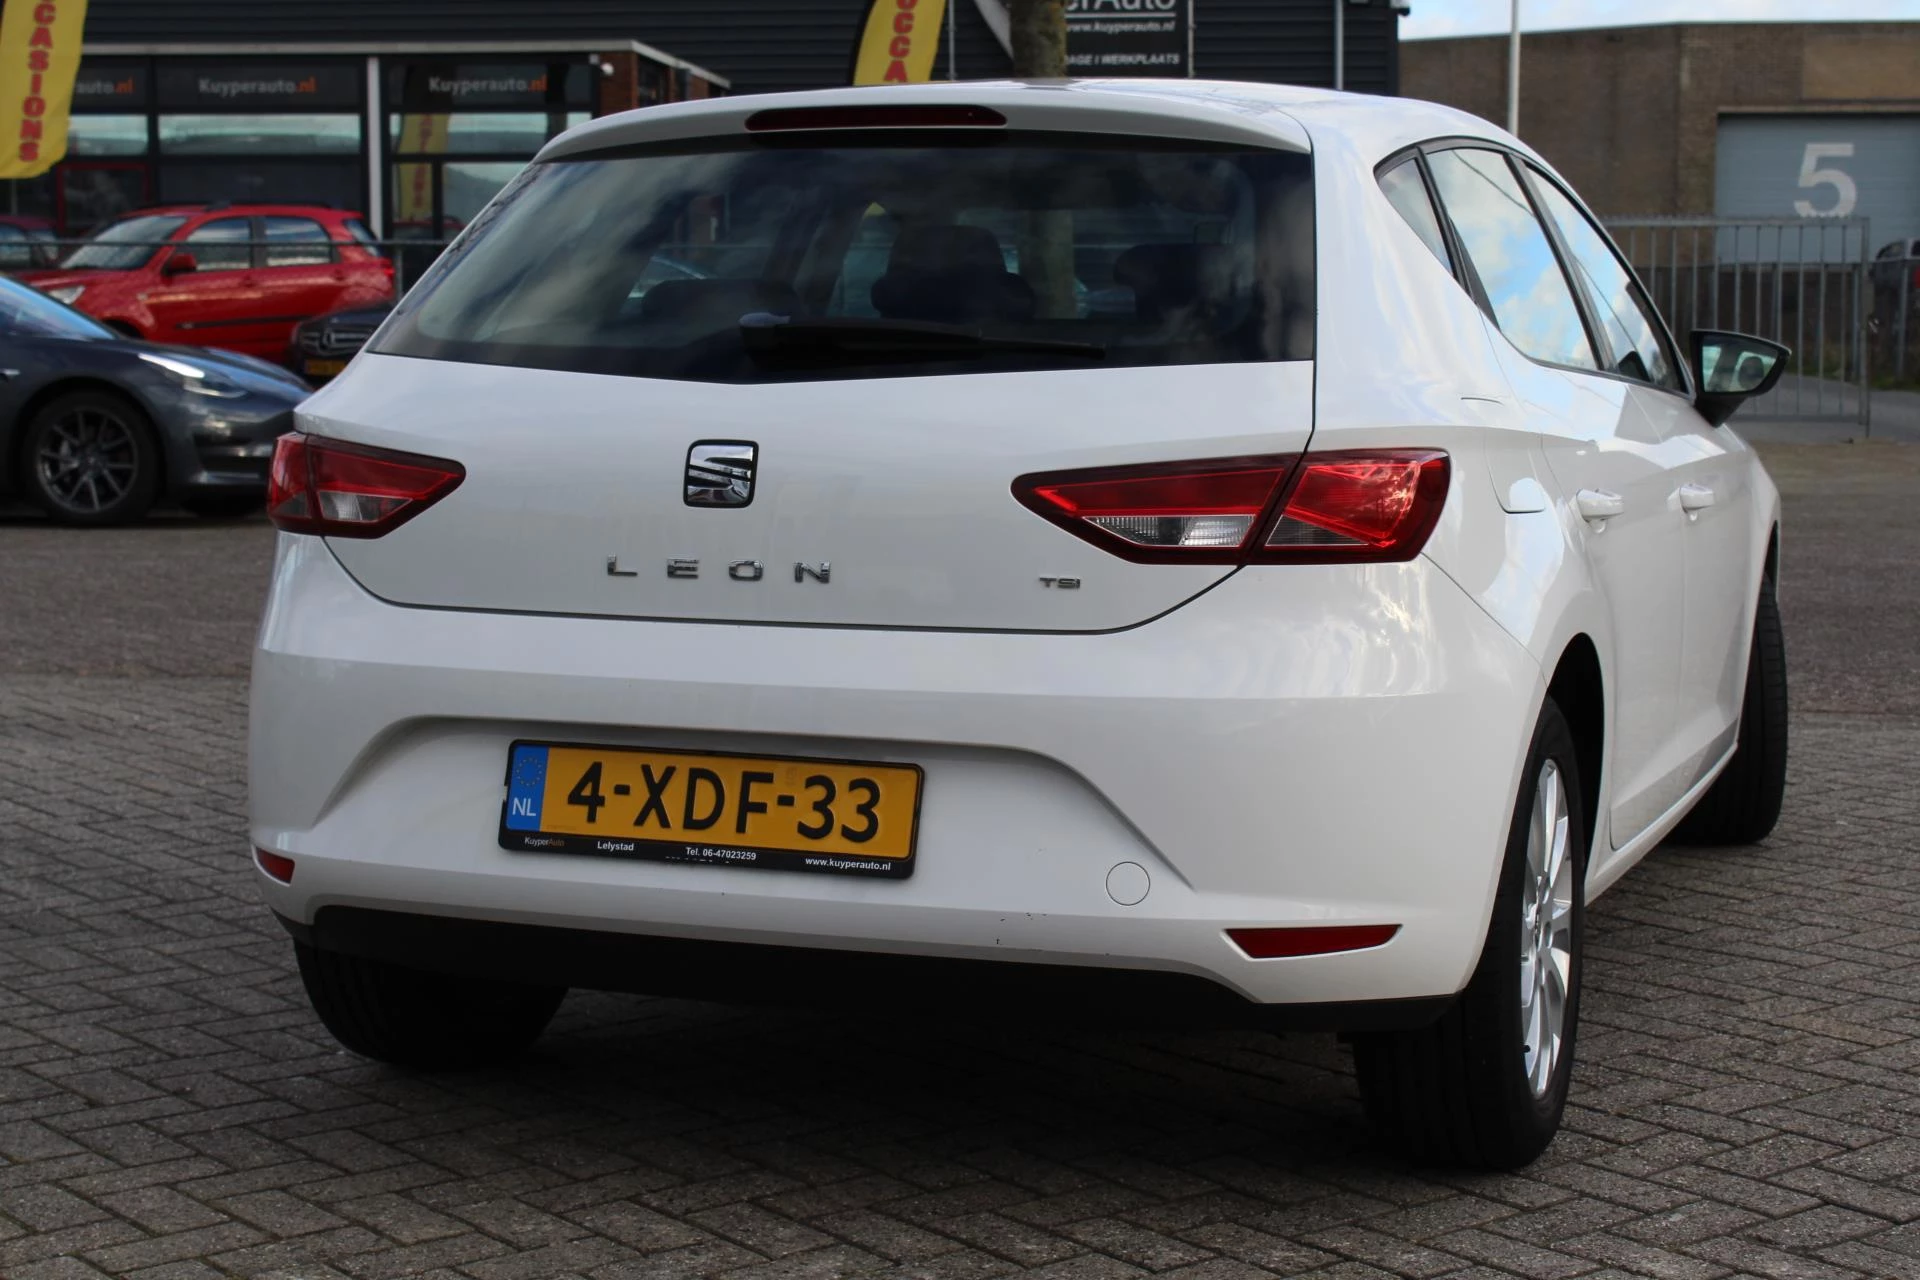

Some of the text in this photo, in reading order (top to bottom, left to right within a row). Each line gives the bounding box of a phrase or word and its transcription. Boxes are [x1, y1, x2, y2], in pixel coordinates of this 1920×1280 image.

[18, 0, 56, 162] CASIONS
[198, 77, 317, 97] Kuyperauto.nl
[428, 75, 548, 95] Kuyperauto.nl
[1793, 143, 1858, 217] 5
[606, 554, 831, 584] LEON
[1038, 577, 1081, 589] TSI
[512, 797, 537, 817] NL
[567, 760, 881, 843] 4-XDF-33
[524, 837, 565, 847] KuyperAuto
[597, 840, 635, 851] Lelystad
[685, 847, 700, 856] Tel.
[702, 848, 757, 860] 06-47023259
[805, 857, 891, 871] www.kuyperauto.nl
